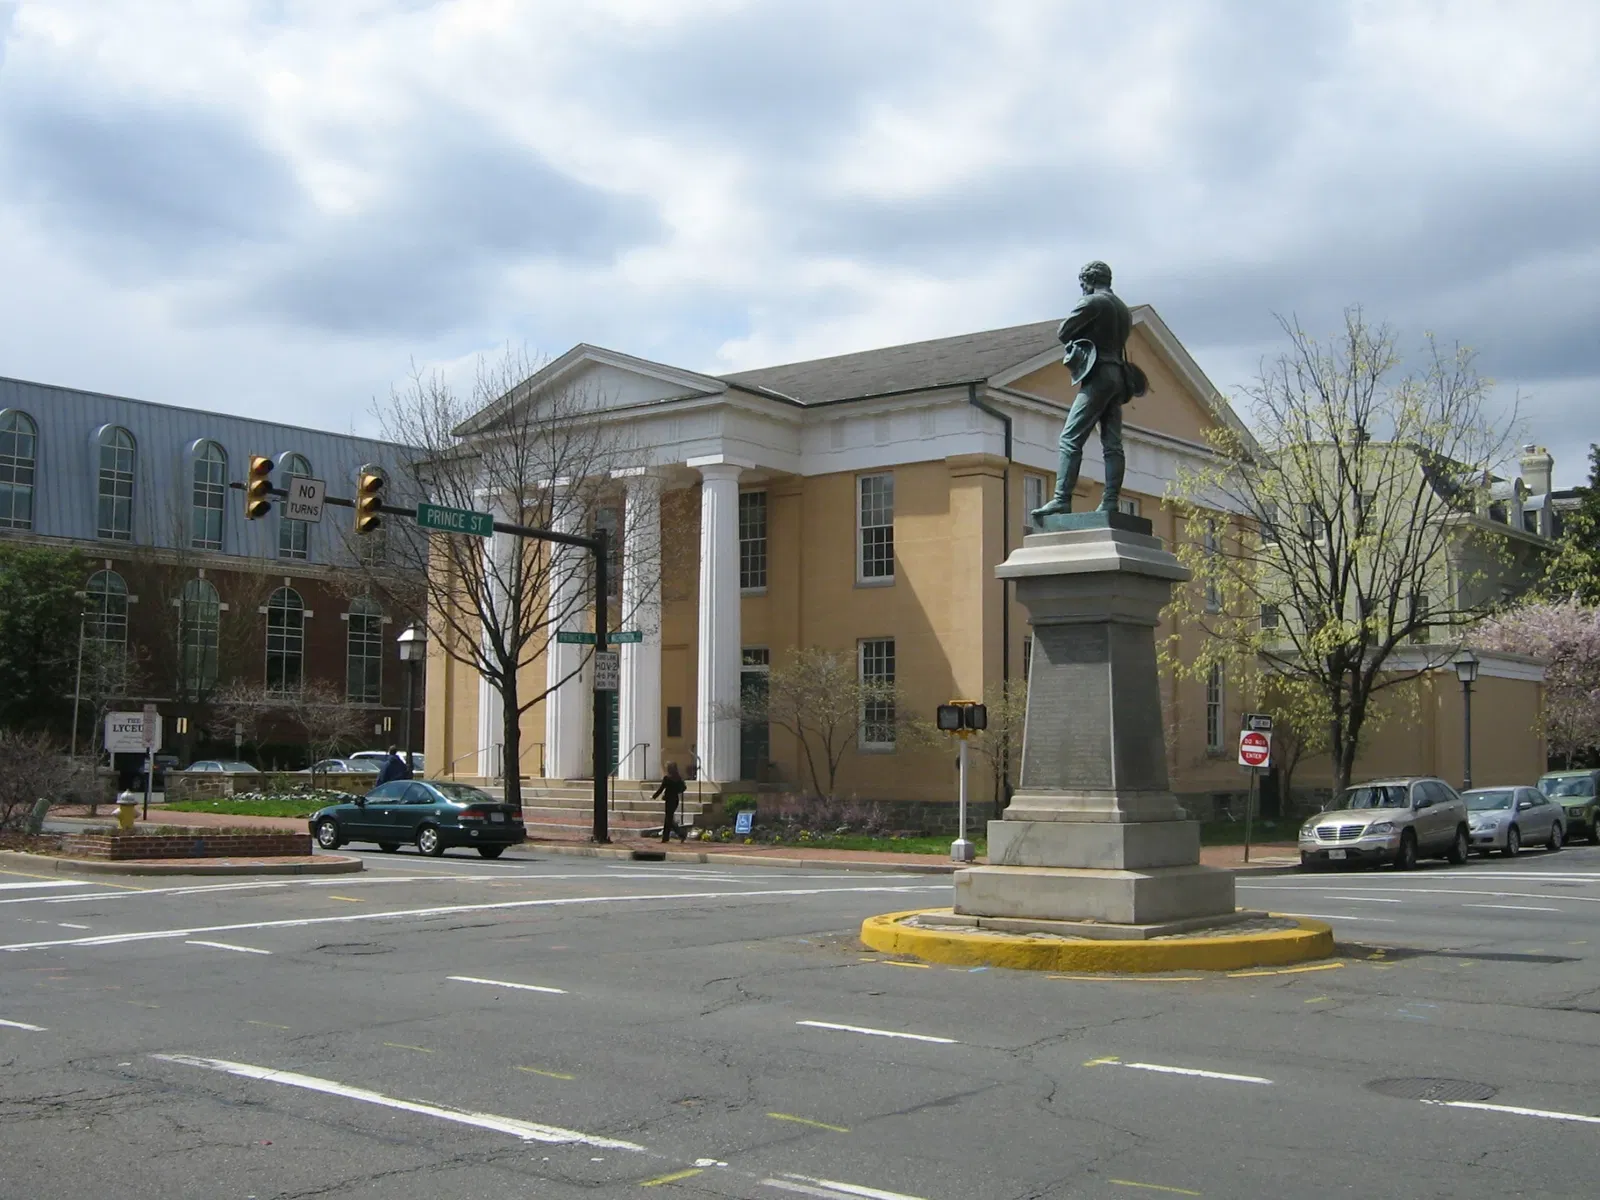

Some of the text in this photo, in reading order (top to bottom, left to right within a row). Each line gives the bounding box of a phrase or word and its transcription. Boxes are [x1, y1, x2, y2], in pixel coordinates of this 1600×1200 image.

[299, 485, 316, 499] NO
[290, 502, 319, 516] TURNS
[427, 508, 484, 531] PRINCE ST
[112, 724, 145, 732] LYCEU
